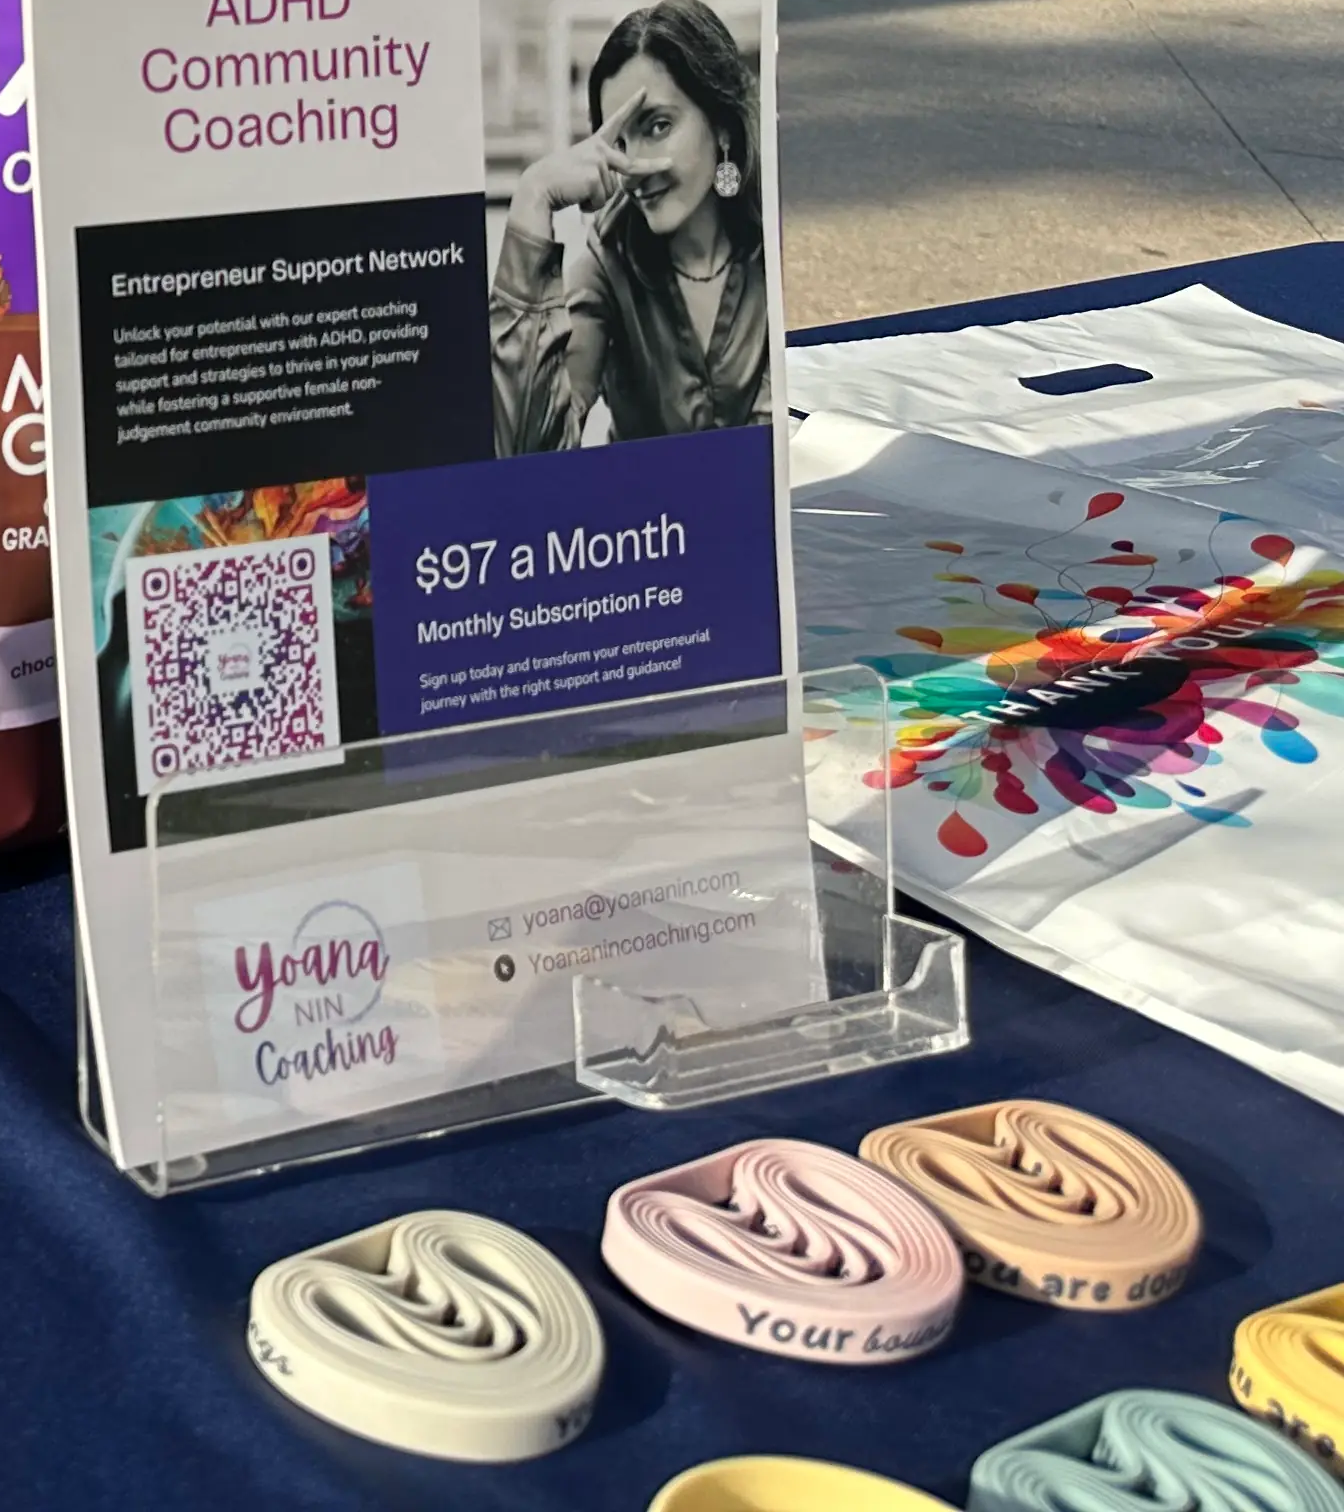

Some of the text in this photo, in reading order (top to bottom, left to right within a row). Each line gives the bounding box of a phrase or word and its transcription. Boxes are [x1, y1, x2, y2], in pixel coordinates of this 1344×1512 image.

[140, 35, 430, 96] Community
[164, 100, 399, 154] Coaching
[111, 241, 465, 297] Entrepreneur Support Network
[113, 300, 417, 344] Unlock your potential with our expert coaching
[114, 349, 168, 368] tailored
[170, 348, 189, 362] for
[192, 339, 286, 359] entrepreneurs
[288, 334, 318, 350] with
[369, 323, 429, 344] providing
[115, 349, 420, 394] support and strategies to thrive in your journey
[116, 377, 382, 417] while fostering a supportive female non-
[116, 402, 354, 446] judgement community environment.
[415, 512, 686, 594] $97 a Month
[417, 586, 683, 644] Monthly Subscription Fee
[419, 628, 710, 690] Sign up today and transform your entrepreneurial
[420, 656, 682, 716] journey with the right support and guidance!
[959, 665, 1143, 725] THANK
[522, 868, 742, 935] yoana@yoananin.com
[528, 908, 757, 976] Yoananincoaching.com
[234, 938, 391, 1034] Yoana
[294, 992, 345, 1028] NIN
[255, 1023, 400, 1087] Coaching
[961, 1250, 1022, 1287] ou
[1041, 1272, 1112, 1302] are
[736, 1301, 853, 1352] Your
